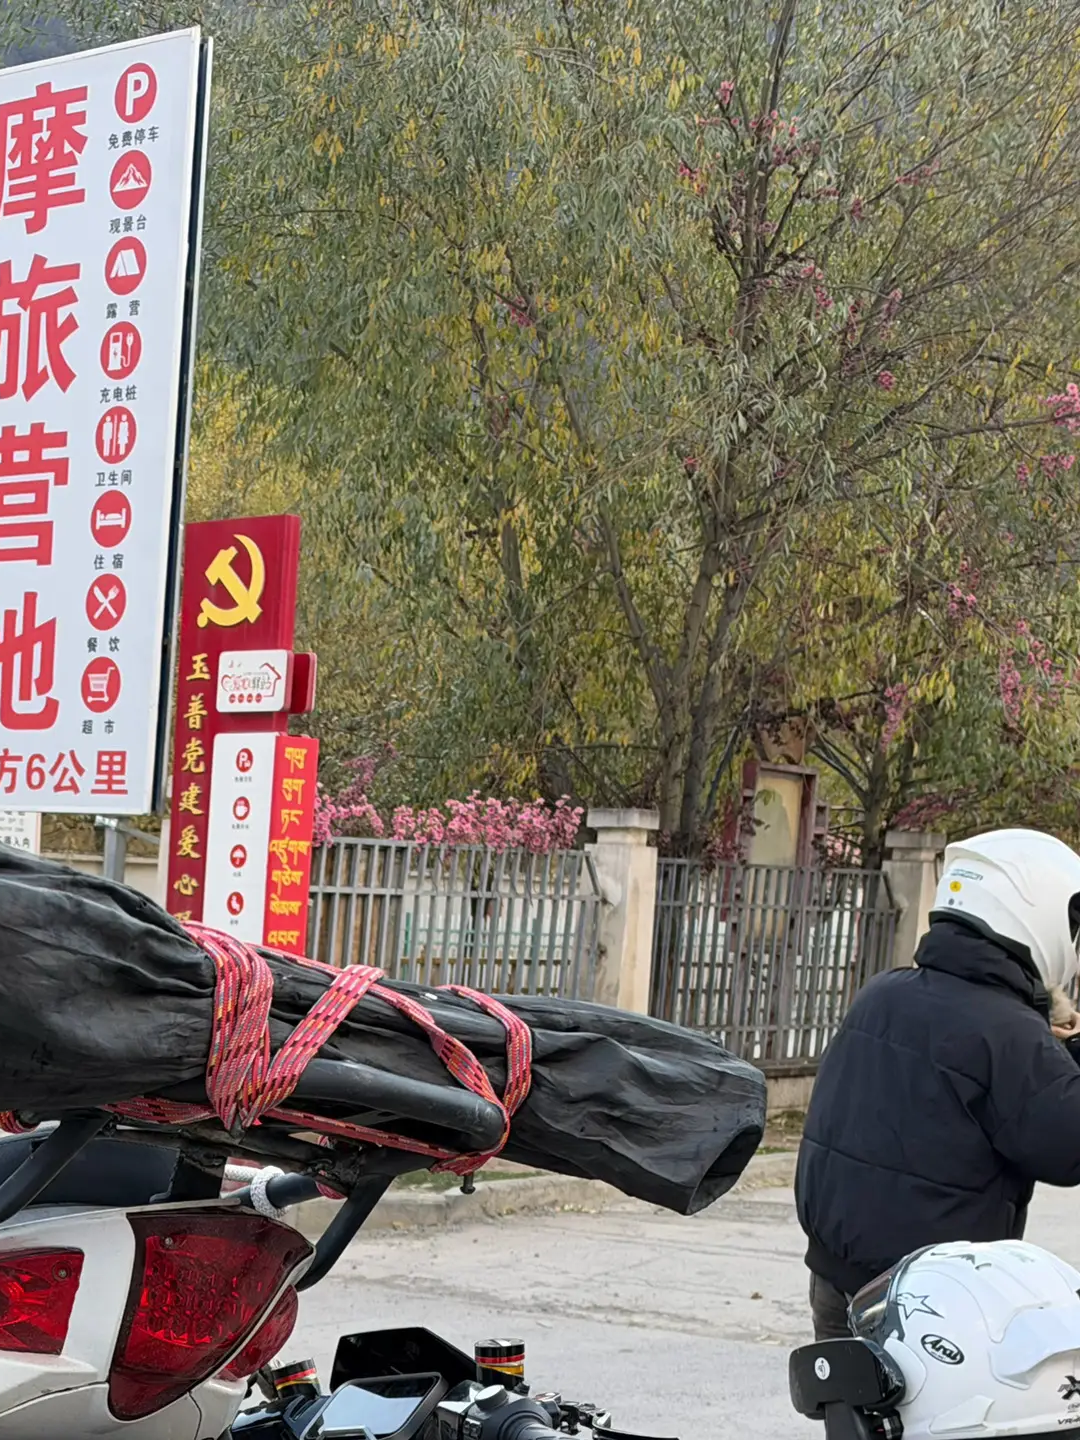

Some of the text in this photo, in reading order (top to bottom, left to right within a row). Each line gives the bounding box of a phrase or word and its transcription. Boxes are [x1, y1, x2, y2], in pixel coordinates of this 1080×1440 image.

[107, 126, 160, 150] 免费停车
[106, 299, 141, 319] 露营
[99, 385, 137, 404] 充电桩
[95, 469, 132, 487] 卫生间
[93, 553, 124, 570] 住宿
[87, 637, 120, 653] 餐饮
[82, 719, 115, 734] 超市
[173, 653, 211, 922] 玉普党建爱心
[925, 1338, 960, 1361] Arai
